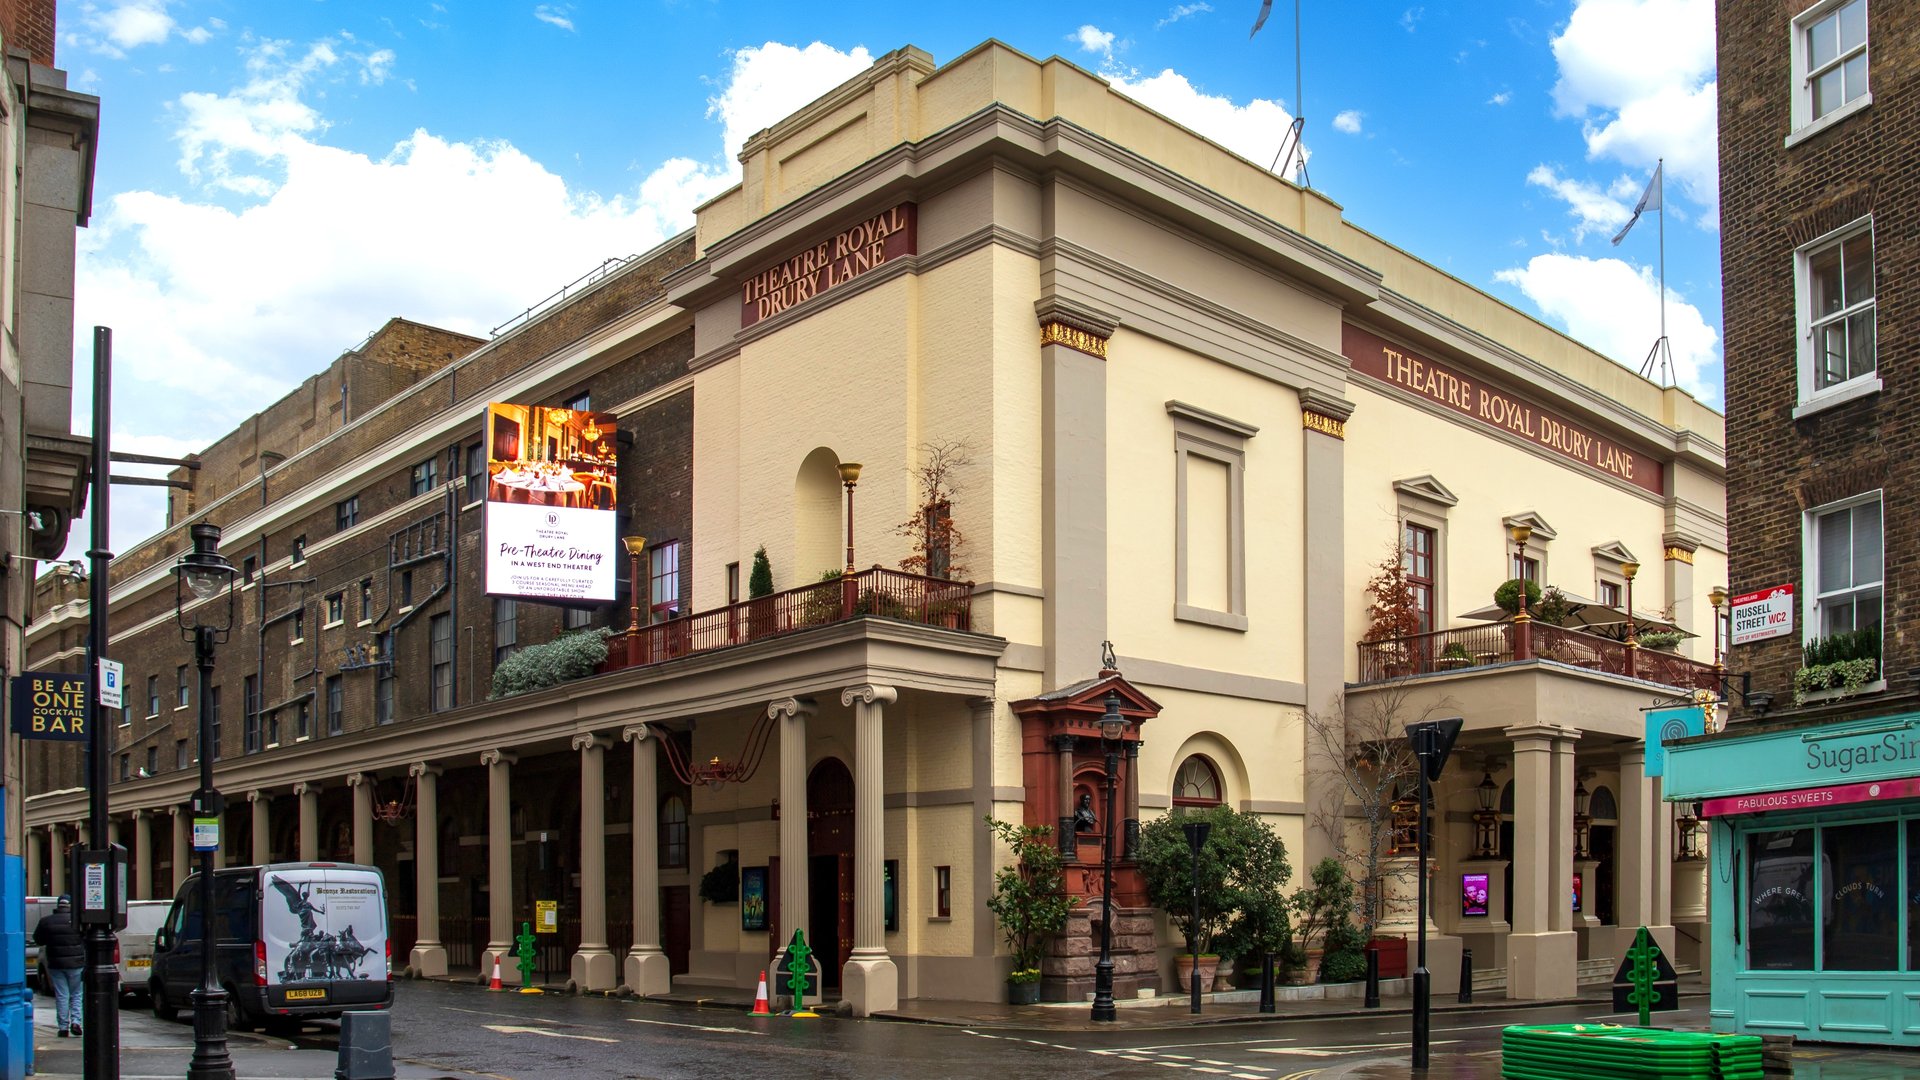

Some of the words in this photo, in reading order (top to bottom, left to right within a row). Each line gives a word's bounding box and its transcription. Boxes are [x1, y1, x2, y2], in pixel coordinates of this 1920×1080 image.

[743, 241, 829, 305] THEATRE
[835, 207, 904, 260] ROYAL
[756, 270, 821, 324] DRURY
[828, 239, 885, 289] LANE
[1383, 347, 1472, 411] THEATRE
[1479, 388, 1535, 438] ROYAL
[1540, 416, 1592, 461] DRURY
[1596, 441, 1634, 480] LANE
[500, 542, 566, 558] Pre-Theatre
[568, 547, 603, 565] Dining
[1736, 602, 1772, 620] RUSSELL
[1736, 616, 1766, 631] STREET
[1768, 612, 1786, 624] WC2
[1751, 629, 1777, 639] WESTMINSTER
[32, 679, 54, 692] BE
[62, 681, 84, 693] AT
[33, 692, 84, 708] ONE
[33, 708, 84, 716] COCKTAIL
[32, 716, 84, 734] BAR
[1738, 796, 1788, 809] FABULOUS
[1791, 792, 1833, 804] SWEETS
[1754, 886, 1782, 905] WHERE
[1785, 887, 1806, 903] GREY
[1835, 882, 1862, 900] CLOUDS
[1866, 882, 1885, 899] TURN
